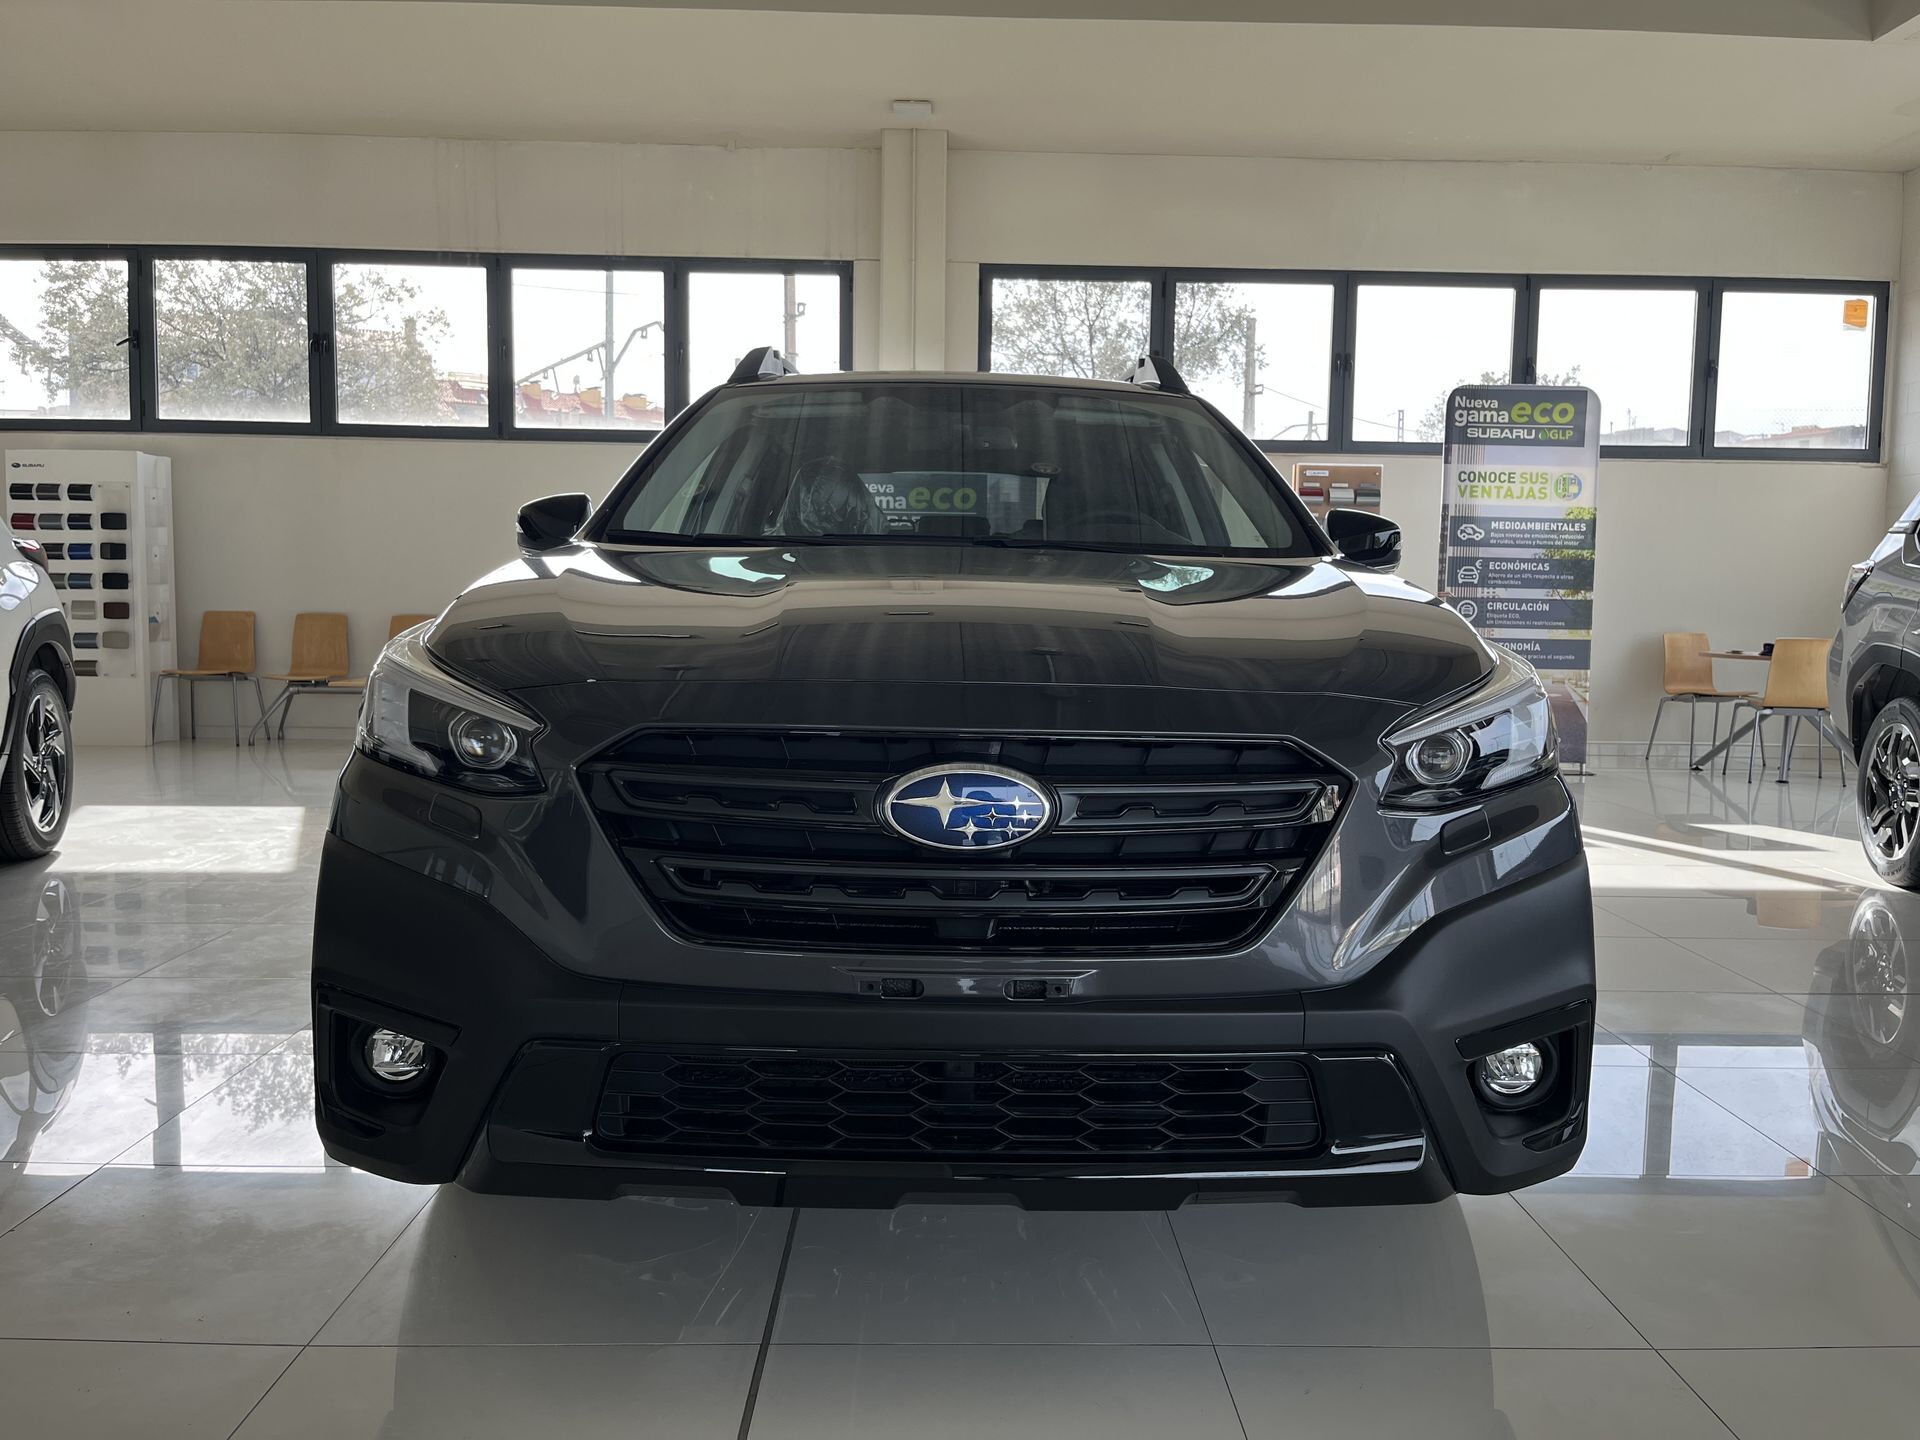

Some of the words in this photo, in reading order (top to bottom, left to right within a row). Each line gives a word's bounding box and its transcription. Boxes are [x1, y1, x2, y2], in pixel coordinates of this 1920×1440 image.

[1455, 395, 1499, 408] Nueva
[1454, 409, 1509, 427] gama
[1511, 402, 1575, 424] eco
[1467, 427, 1536, 439] SUBARU
[1549, 429, 1574, 440] GLP
[1458, 471, 1517, 484] CONOCE
[1519, 472, 1549, 485] SUS
[865, 483, 895, 494] eva
[1458, 485, 1548, 500] VENTAJAS
[908, 486, 977, 510] eco
[1491, 521, 1587, 532] MEDIOAMBIENTALES
[1489, 560, 1550, 571] ECONÓMICAS
[1487, 601, 1550, 612] CIRCULACIÓN
